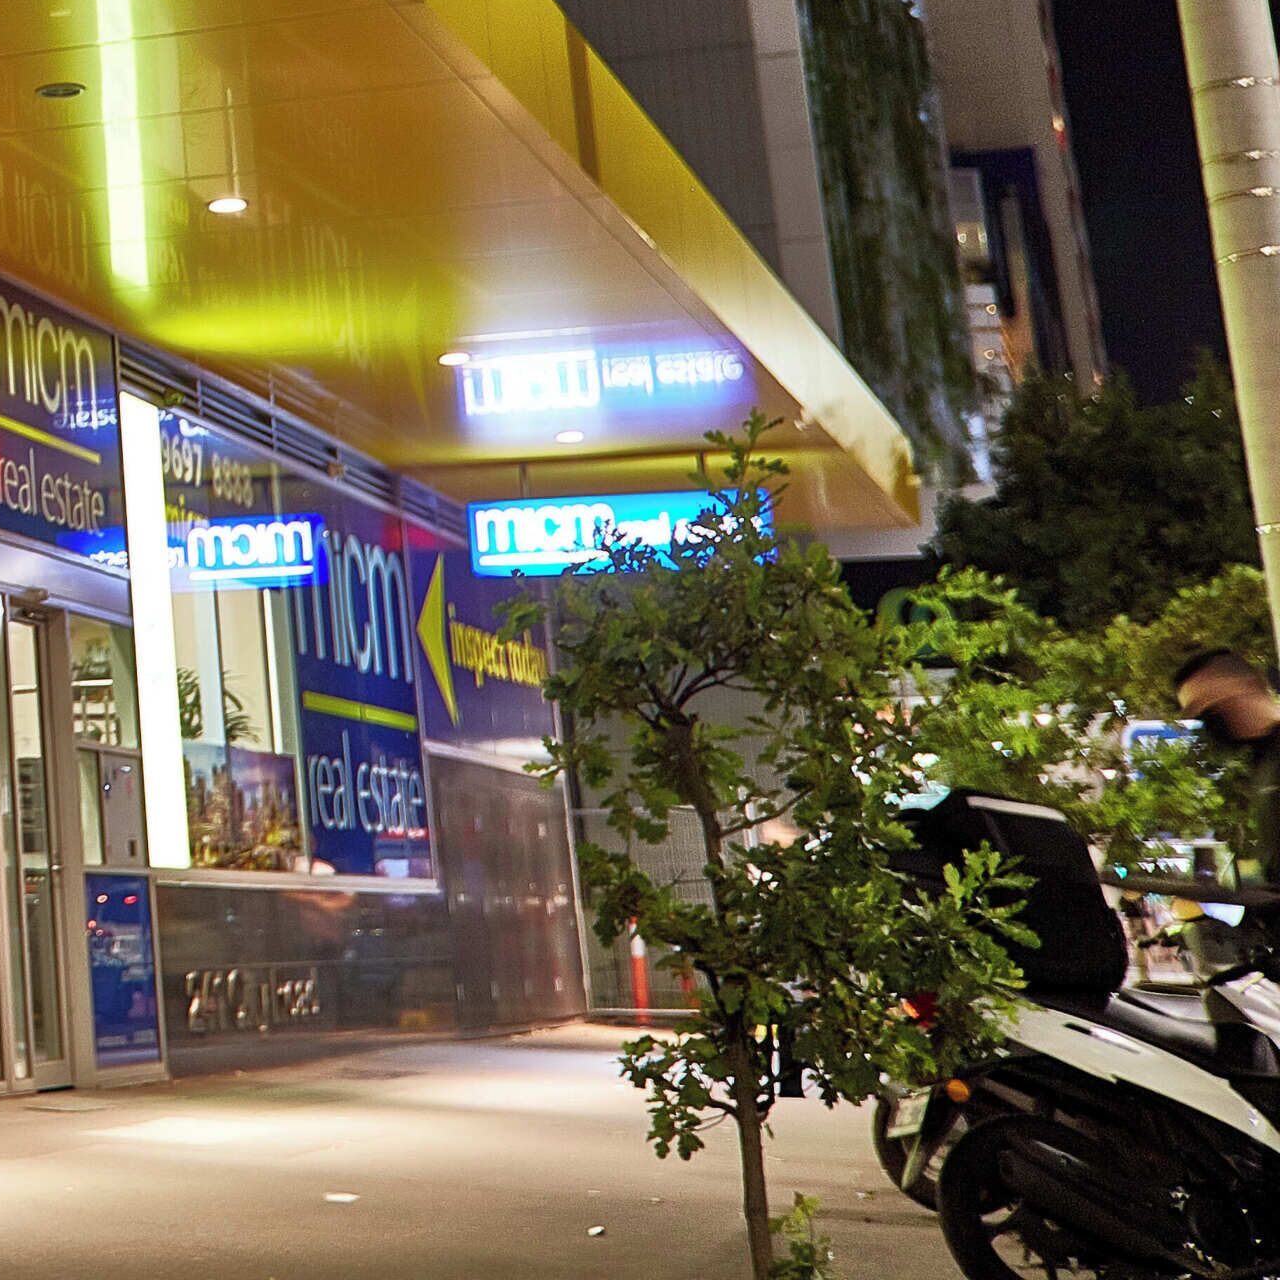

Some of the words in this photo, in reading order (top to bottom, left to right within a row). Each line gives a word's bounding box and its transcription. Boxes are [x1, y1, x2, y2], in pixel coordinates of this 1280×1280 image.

[41, 471, 105, 532] estate
[308, 729, 356, 829] real
[356, 754, 424, 837] estate
